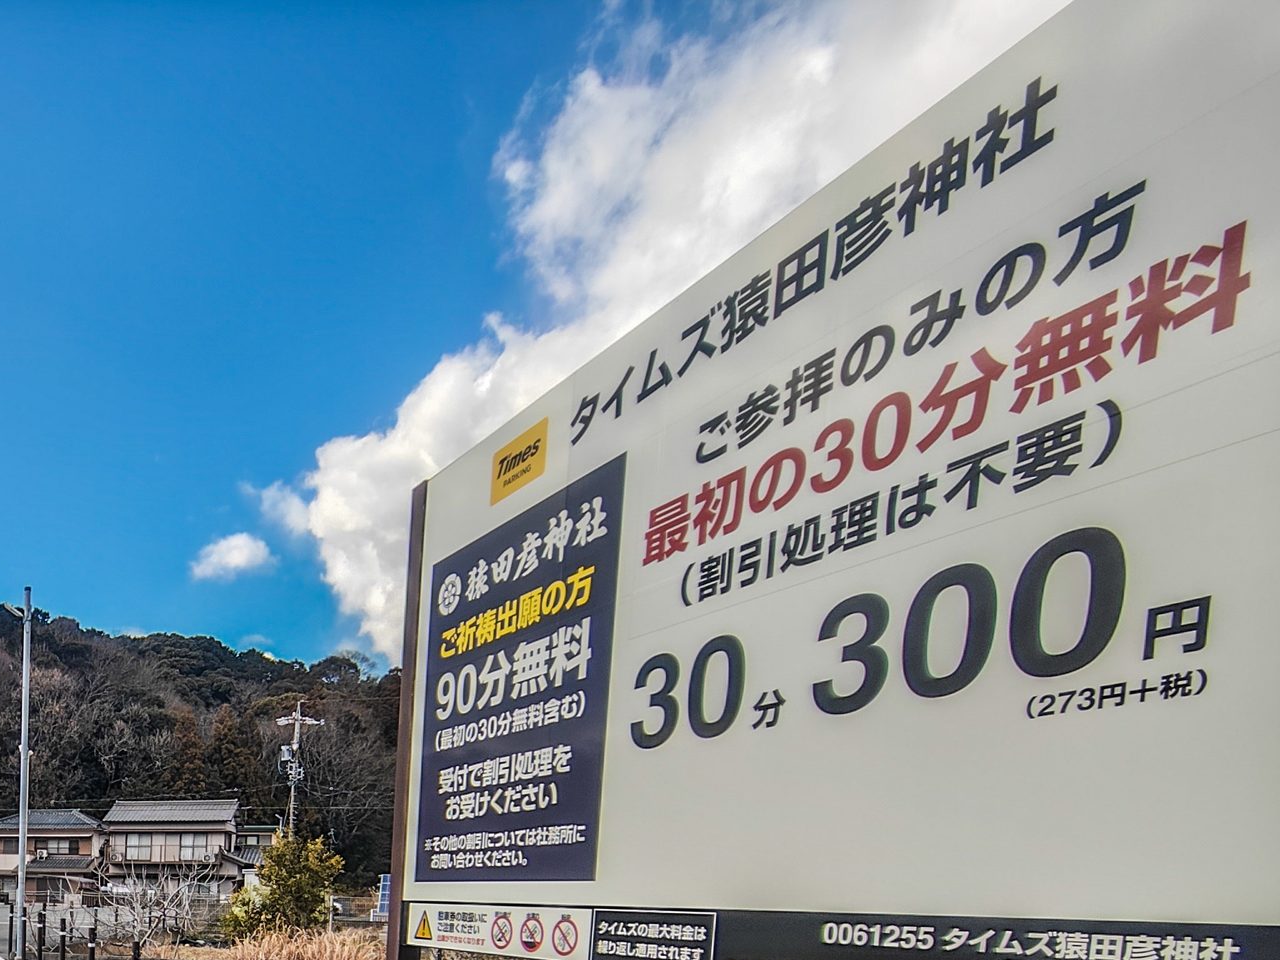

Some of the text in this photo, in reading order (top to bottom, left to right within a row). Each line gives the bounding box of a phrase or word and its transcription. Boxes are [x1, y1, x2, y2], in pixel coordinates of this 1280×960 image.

[570, 76, 1059, 445] タイムズ猿田彦神社
[694, 180, 1147, 465] ご参拝のみの方
[642, 220, 1250, 568] 最初の30分無料
[496, 438, 542, 480] Times
[502, 464, 532, 488] PARKING
[680, 400, 1123, 606] (割引処理は不要)
[464, 496, 609, 601] 猿田彦神社
[440, 565, 596, 658] ご祈祷出願の方
[437, 616, 593, 721] 90分無料
[629, 633, 786, 750] 30分
[435, 691, 586, 752] (最初の30分無料含む)
[438, 745, 573, 794] 受付で割引処理を
[445, 783, 558, 820] お受けください
[430, 850, 528, 869] お問い合わせください。
[598, 921, 707, 941] タイムズの最大料金は
[823, 921, 935, 950] 0061255
